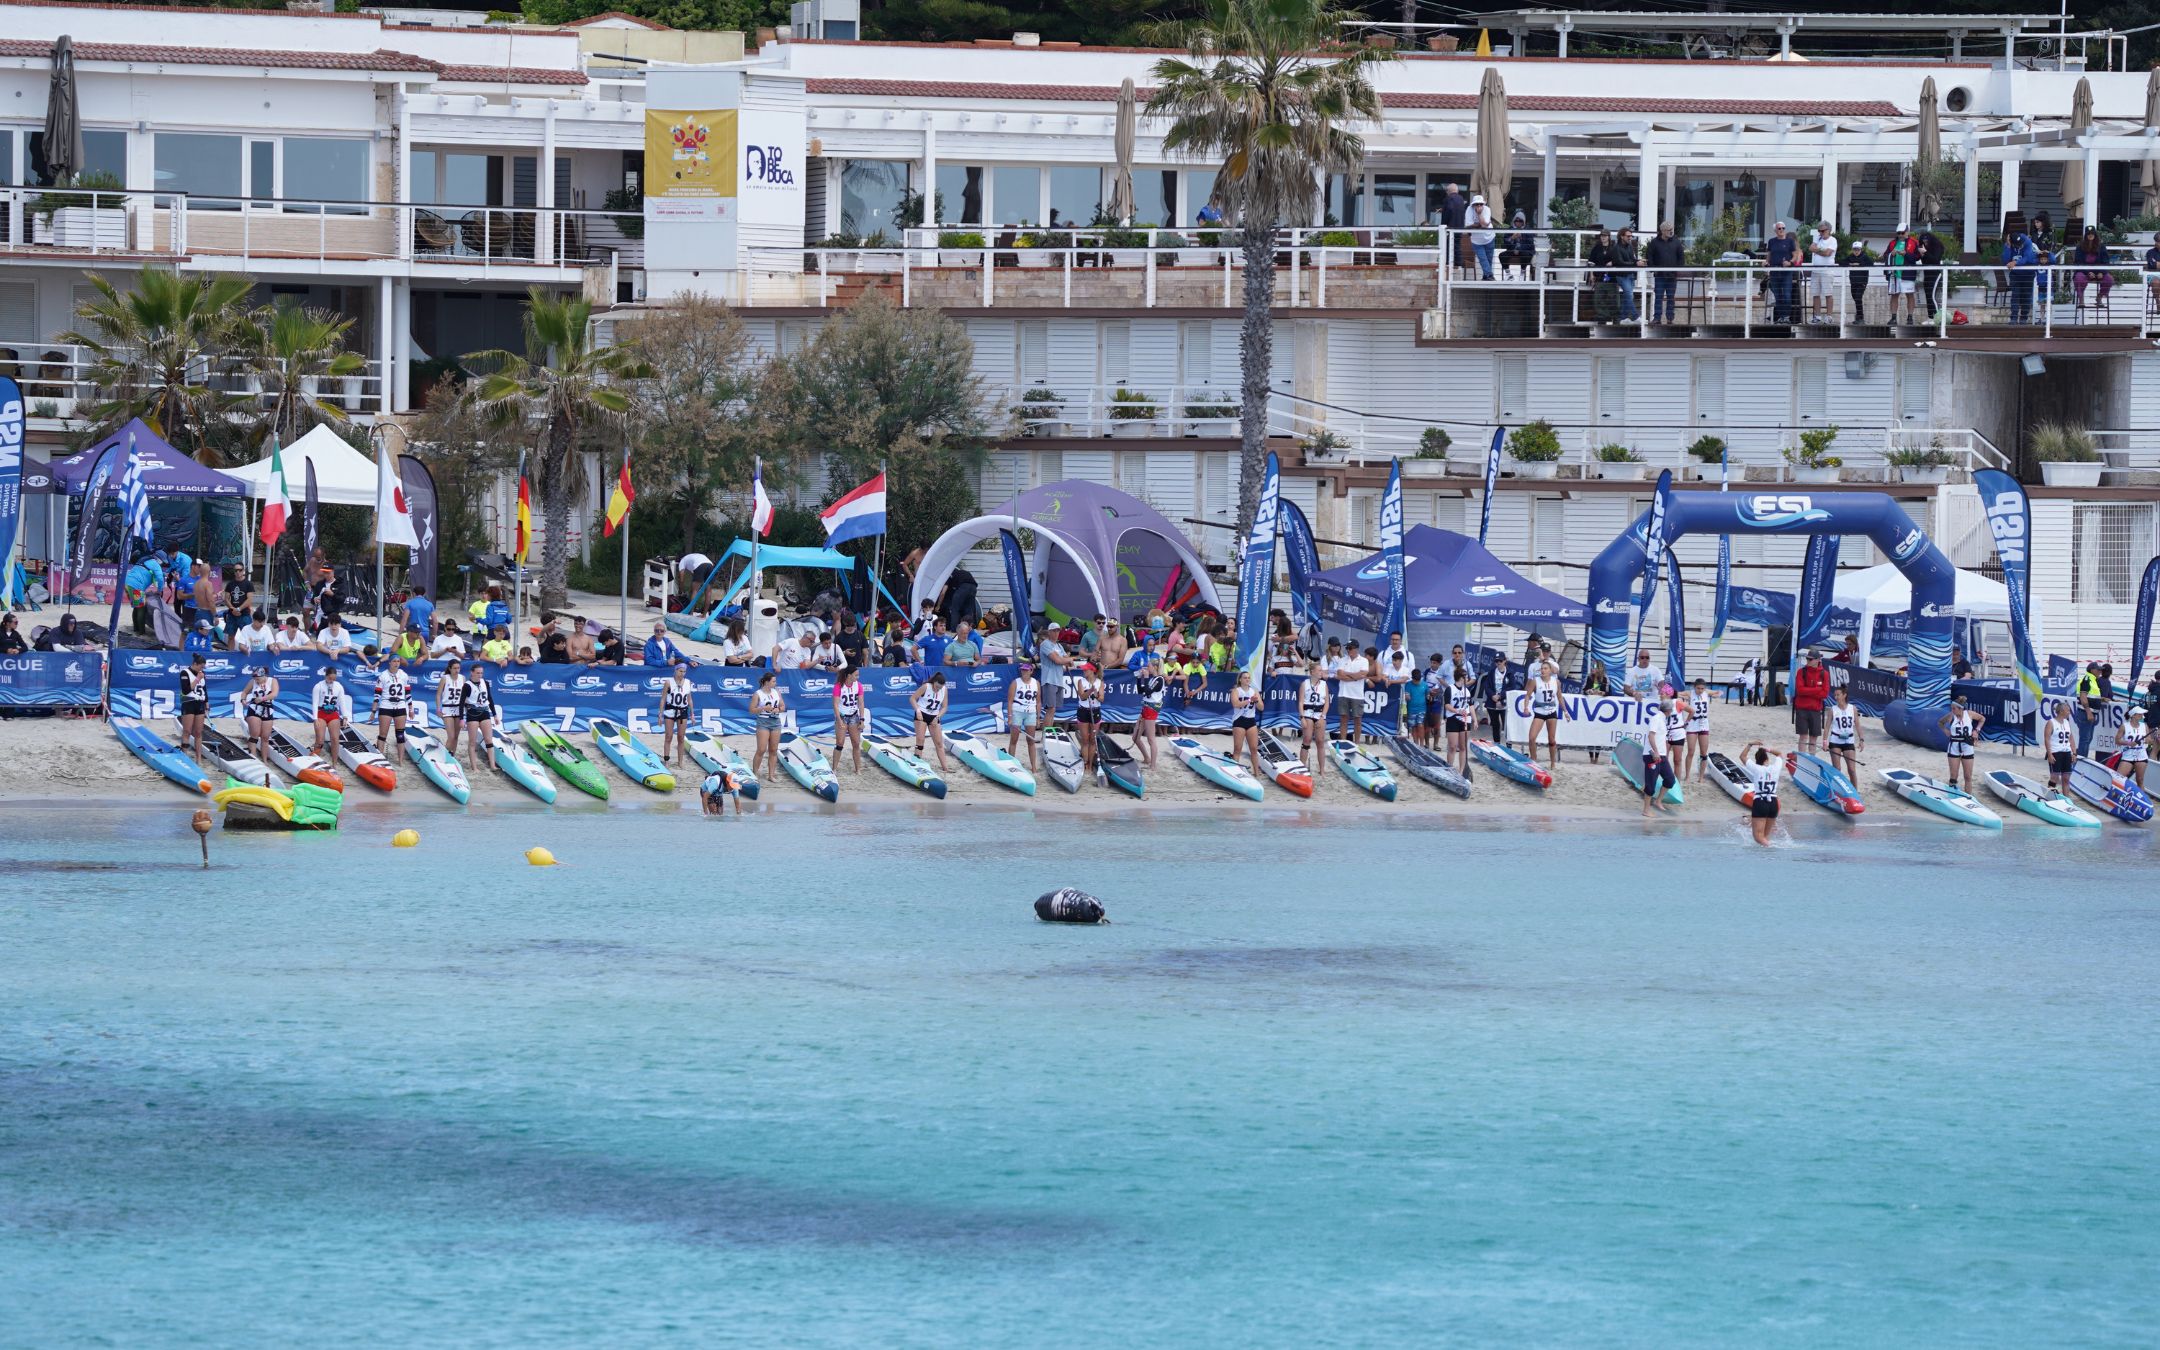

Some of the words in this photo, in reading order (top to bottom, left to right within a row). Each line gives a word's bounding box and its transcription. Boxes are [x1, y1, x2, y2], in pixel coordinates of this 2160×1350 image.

[768, 146, 782, 159] TO
[768, 158, 781, 171] BE
[768, 169, 793, 184] DUCA
[91, 577, 112, 586] TODAY
[1808, 578, 1817, 617] EUROPEAN
[388, 683, 403, 696] 62
[448, 687, 461, 700] 35
[1542, 689, 1553, 702] 13
[135, 688, 176, 719] 12
[323, 695, 338, 706] 56
[476, 692, 487, 704] 45
[926, 698, 940, 711] 27
[1120, 684, 1138, 694] YEA
[1364, 690, 1388, 713] SP
[1515, 693, 1659, 725] CNVOTIS
[1695, 701, 1707, 714] 33
[554, 706, 576, 731] 7
[627, 708, 652, 733] 6
[702, 708, 723, 735] 5
[989, 701, 1005, 732] 1
[1835, 716, 1853, 729] 183
[1610, 731, 1647, 745] IBERI
[1955, 726, 1969, 737] 58
[2058, 731, 2070, 743] 95
[1758, 781, 1776, 793] 157
